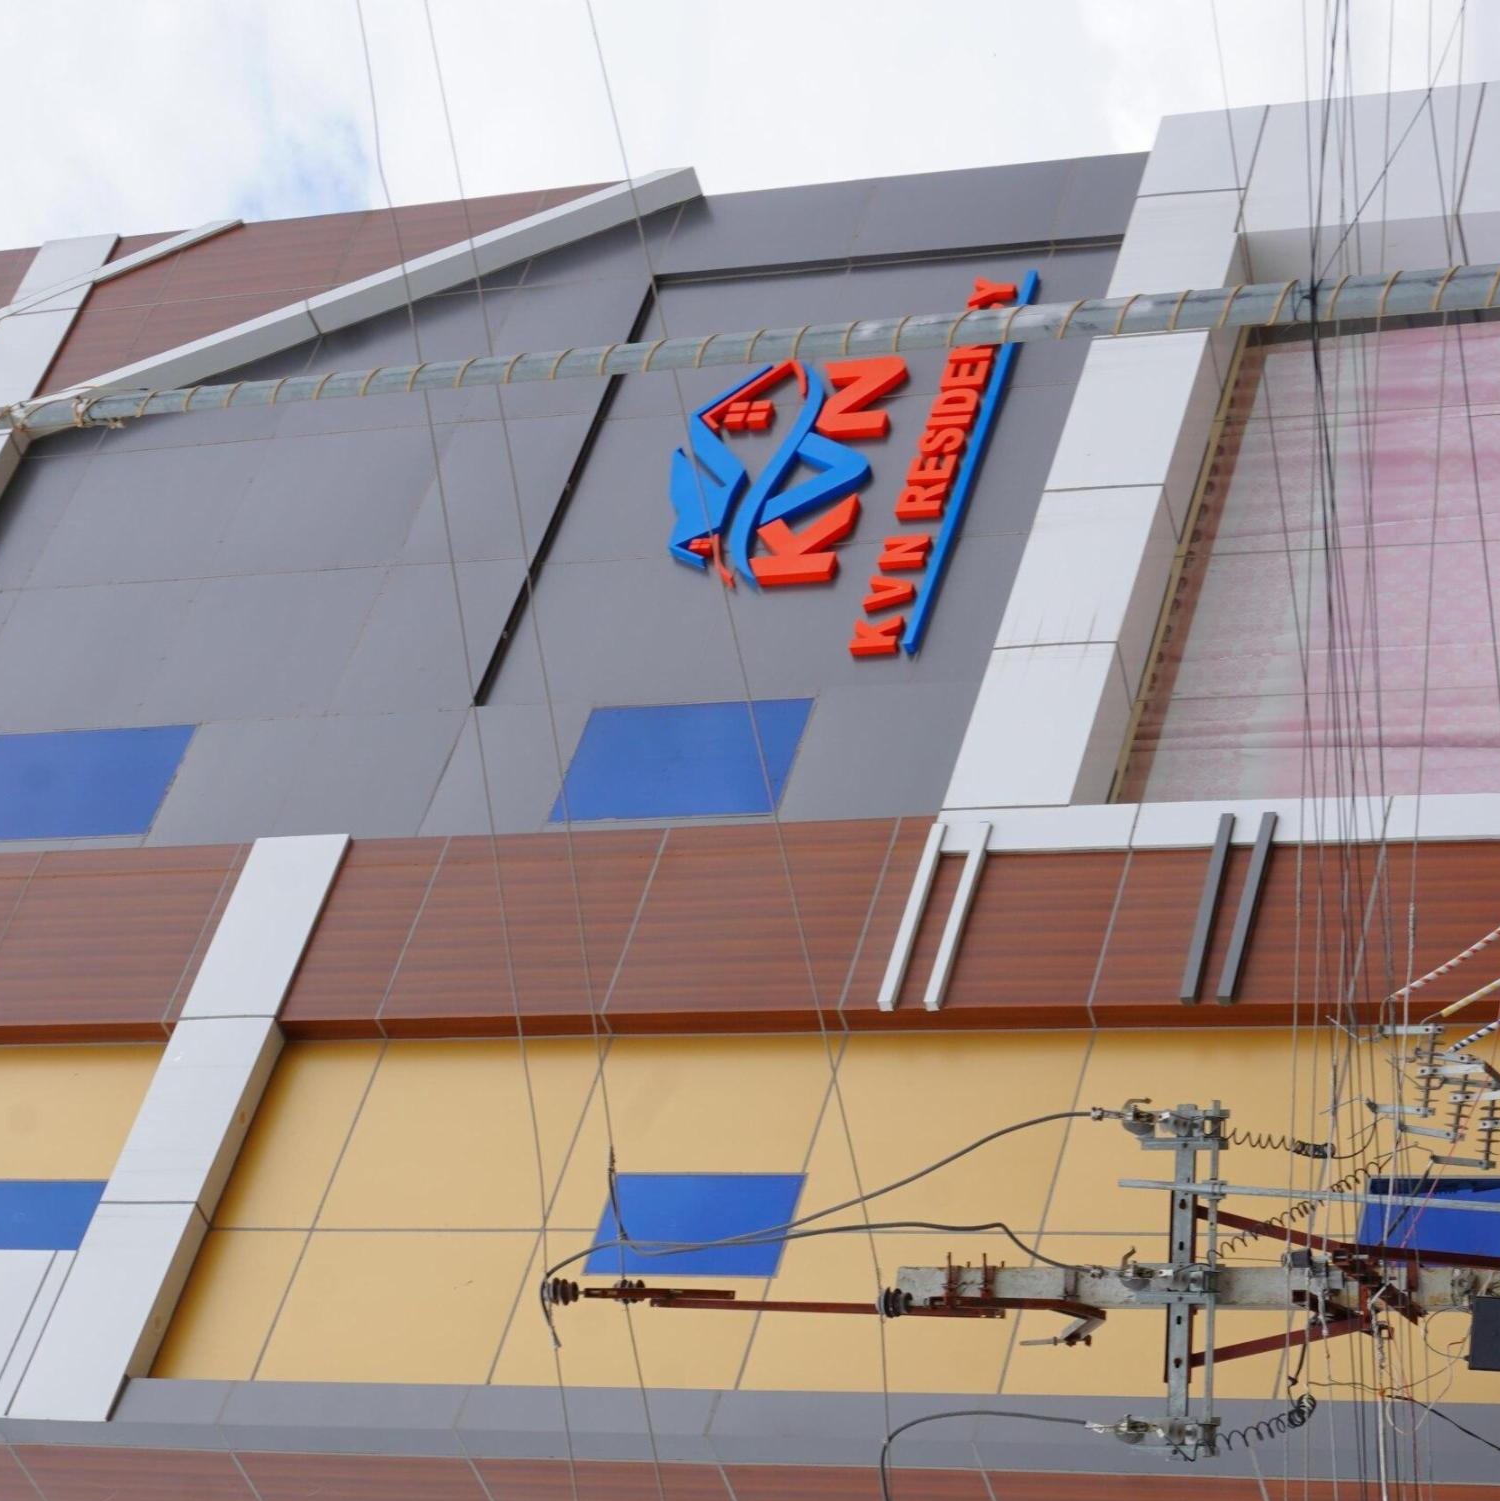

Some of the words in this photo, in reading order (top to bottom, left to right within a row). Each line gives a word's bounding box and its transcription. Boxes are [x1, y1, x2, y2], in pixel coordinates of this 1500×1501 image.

[749, 356, 909, 587] KVN
[848, 535, 931, 658] KVN
[894, 276, 1016, 520] RESIDENY
